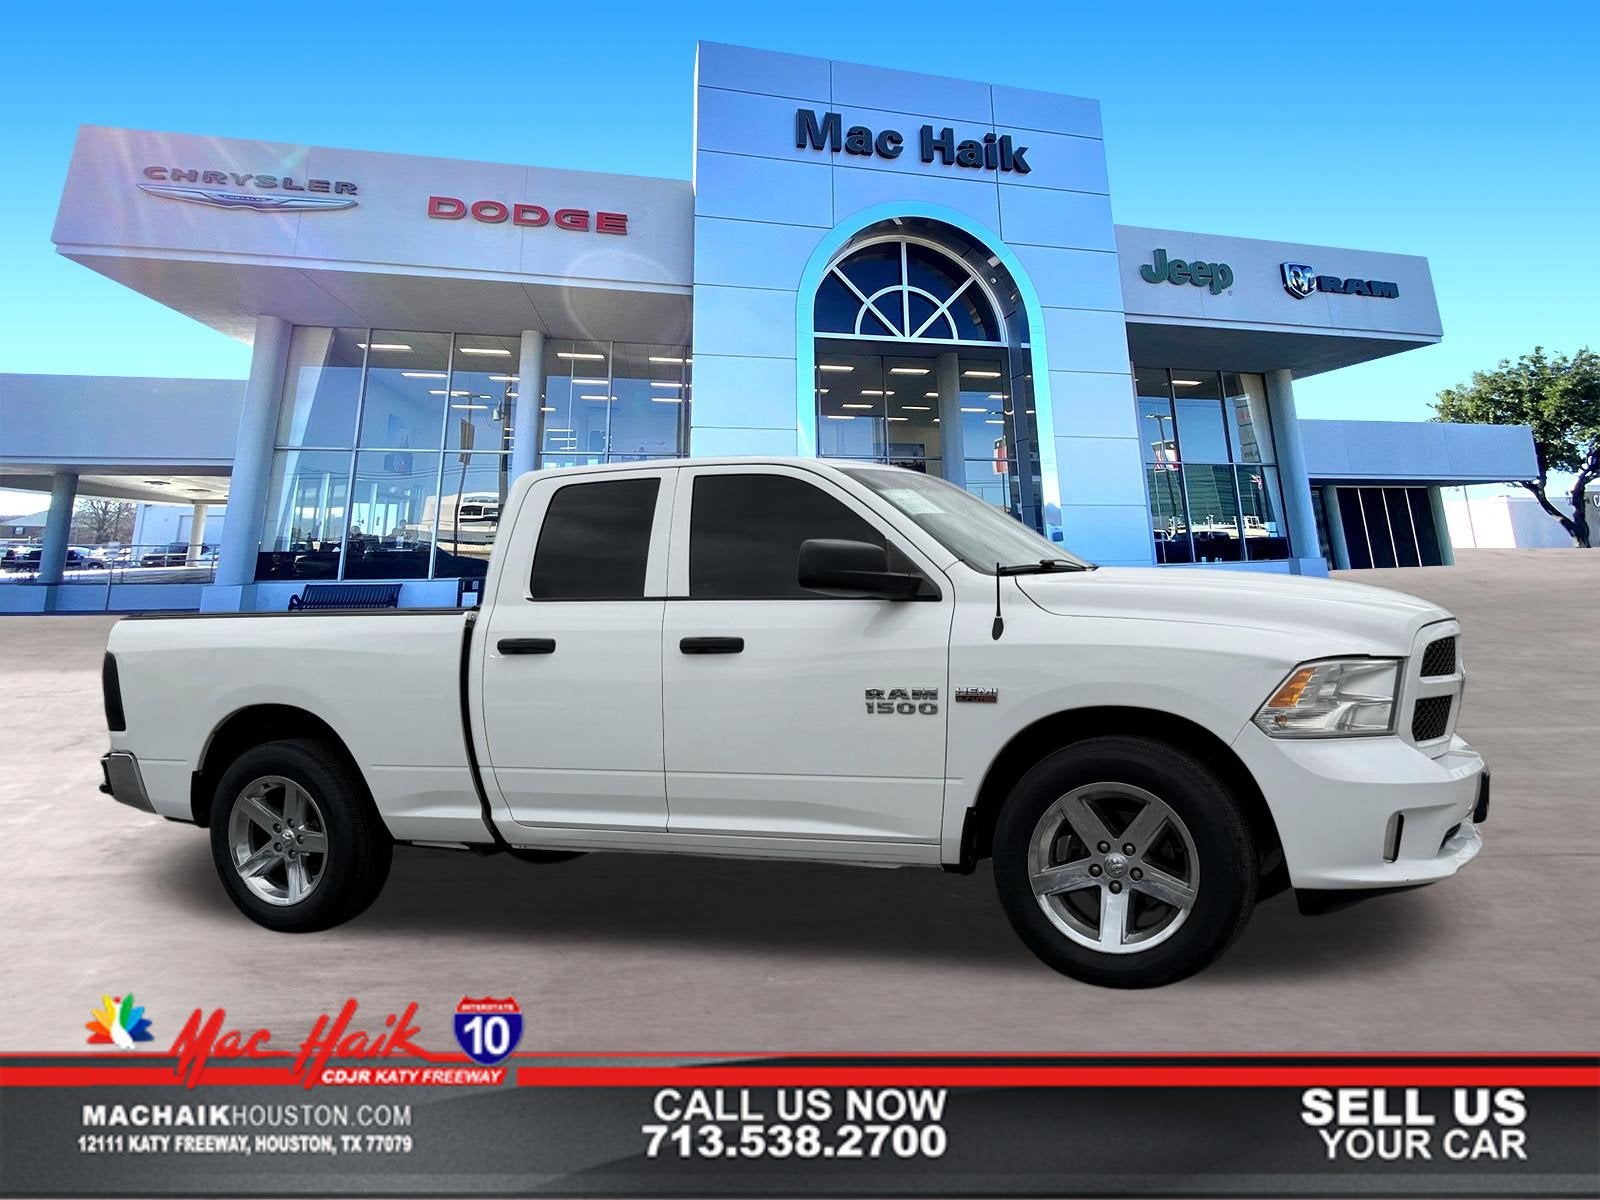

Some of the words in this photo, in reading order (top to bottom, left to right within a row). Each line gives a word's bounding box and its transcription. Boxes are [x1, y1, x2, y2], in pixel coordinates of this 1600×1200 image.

[796, 108, 904, 160] Mac
[920, 124, 1032, 174] Haik
[142, 165, 359, 196] CHRYSLER
[428, 195, 629, 236] DODGE
[1140, 248, 1234, 295] Jeep
[1316, 275, 1400, 299] RAM
[865, 687, 938, 700] RAM
[865, 702, 938, 715] 1500
